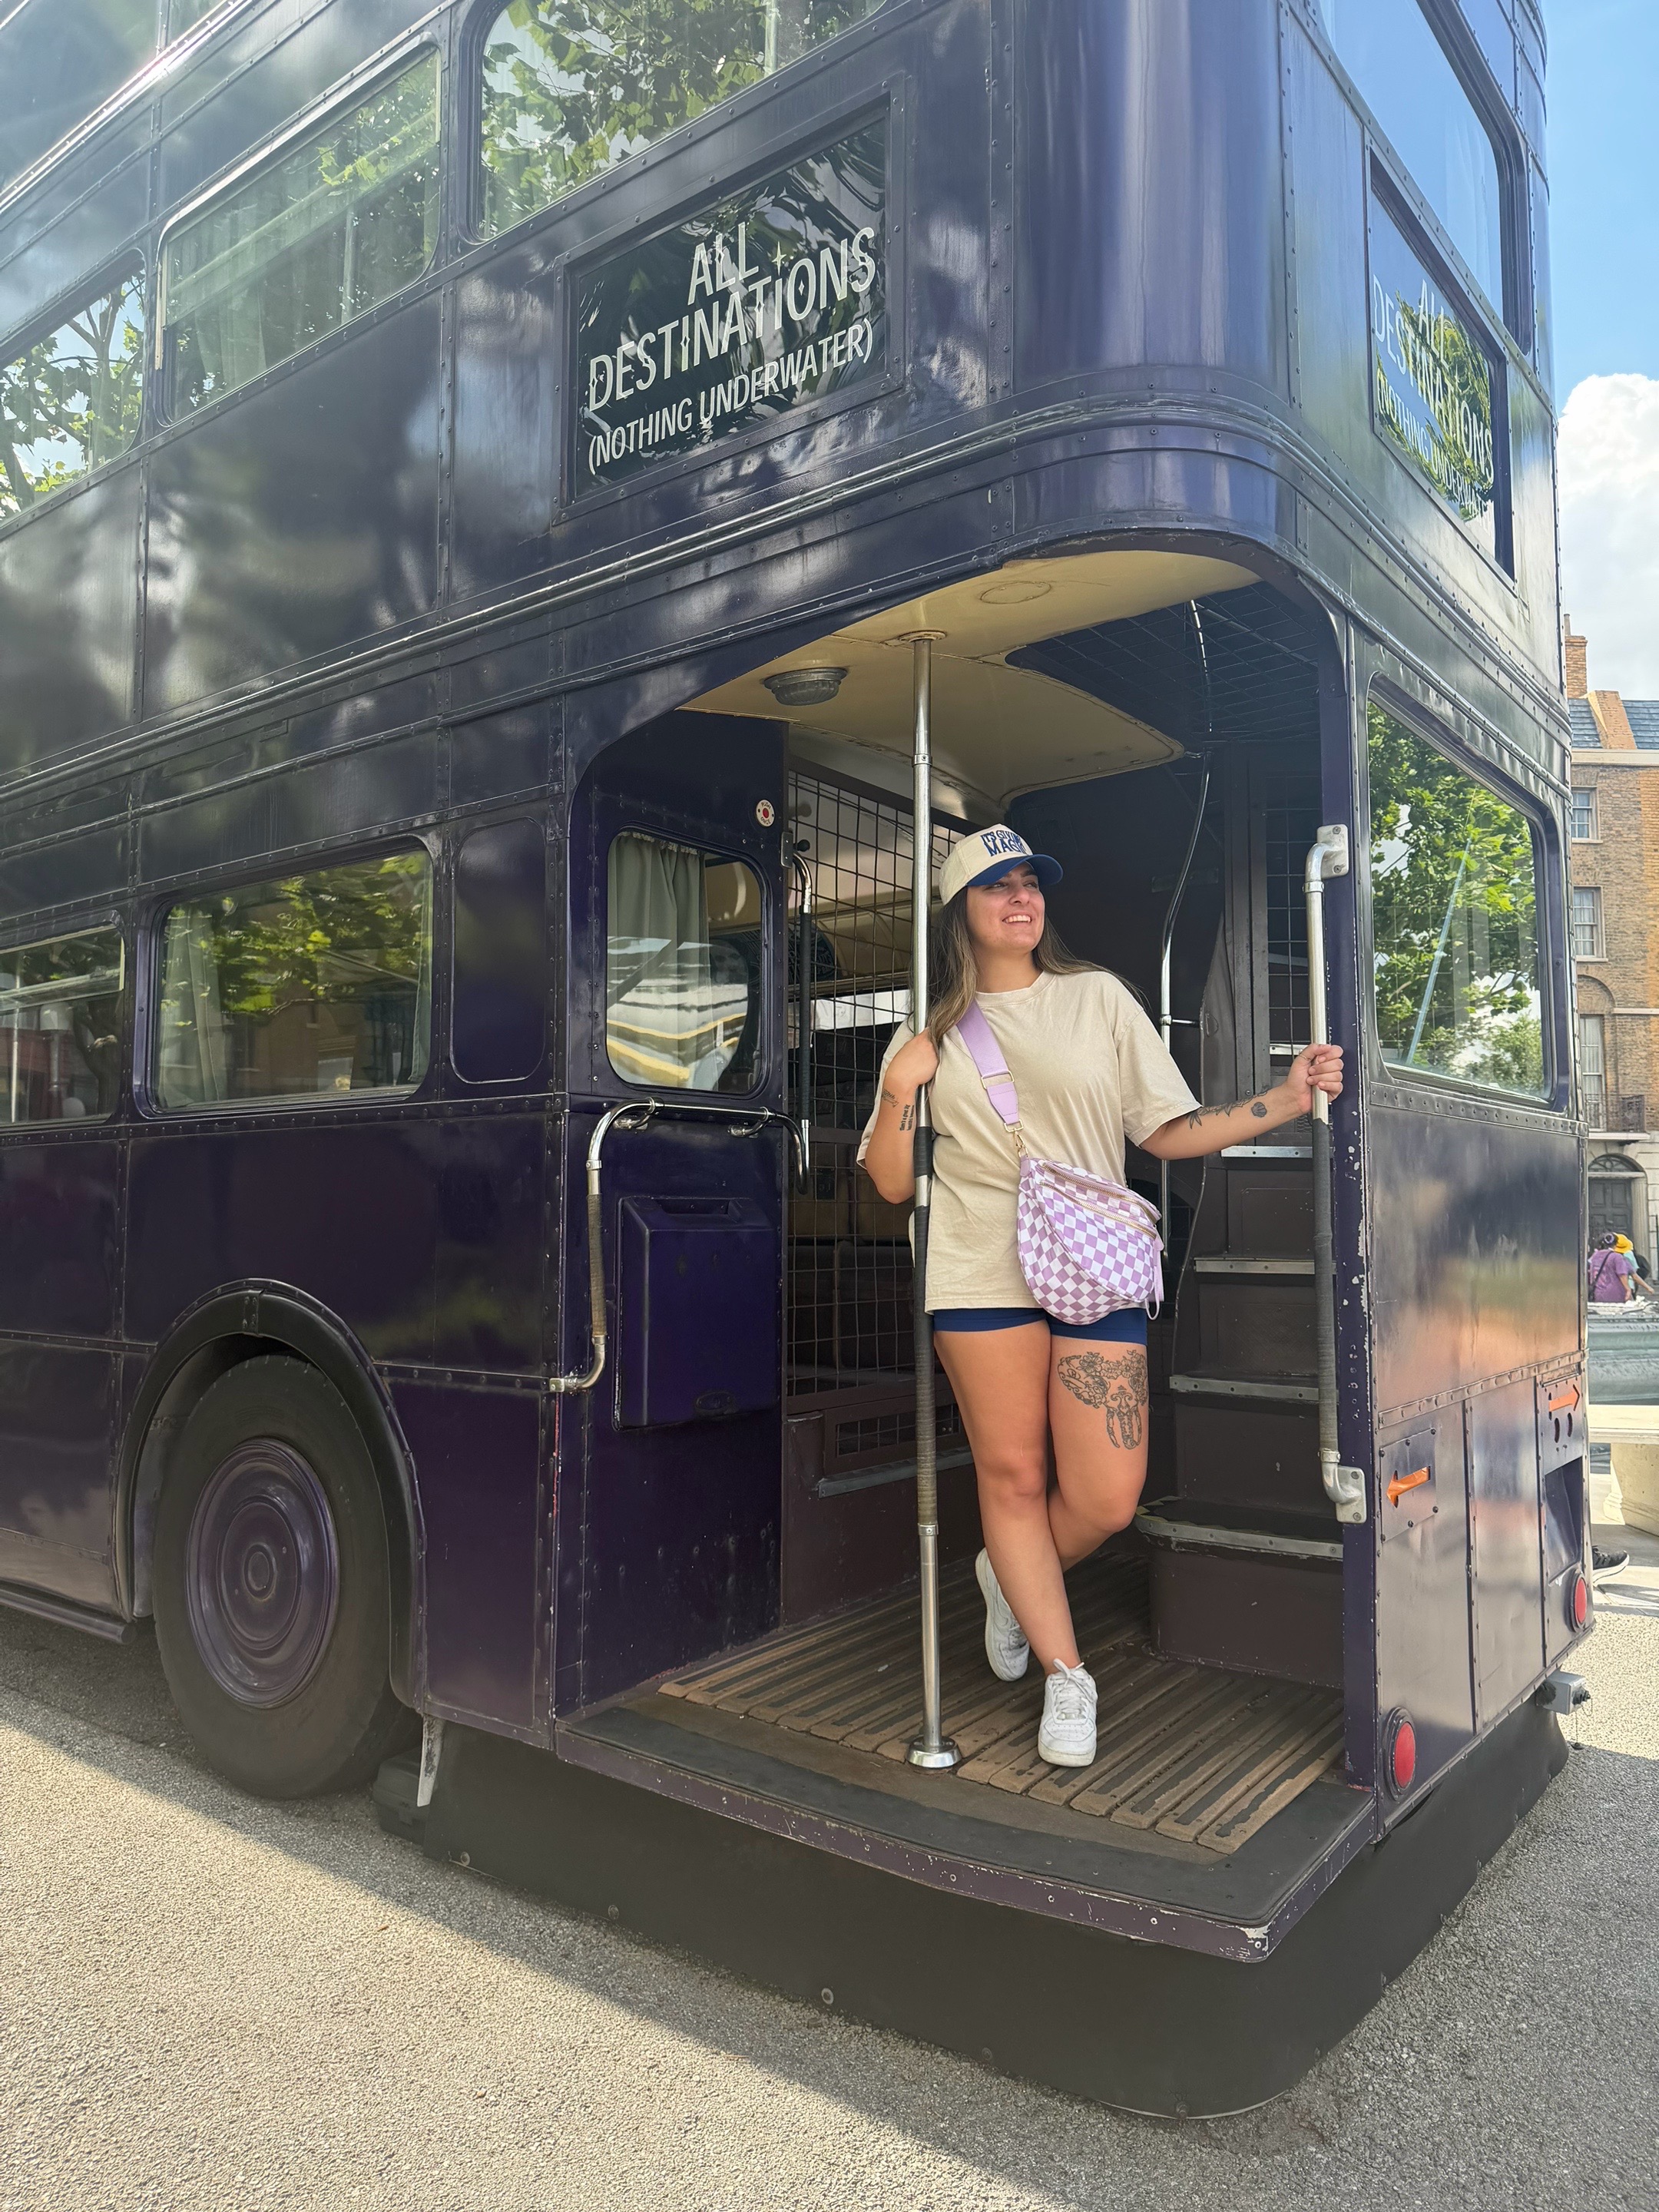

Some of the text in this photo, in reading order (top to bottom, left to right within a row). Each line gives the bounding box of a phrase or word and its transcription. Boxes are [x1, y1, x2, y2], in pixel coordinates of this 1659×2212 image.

[588, 227, 876, 412] DESTINATIONS
[687, 222, 759, 306] ALL
[1418, 278, 1449, 370] ALL
[588, 317, 874, 475] (NOTHING UNDERWATER)
[1373, 273, 1495, 485] DESTINATIONS
